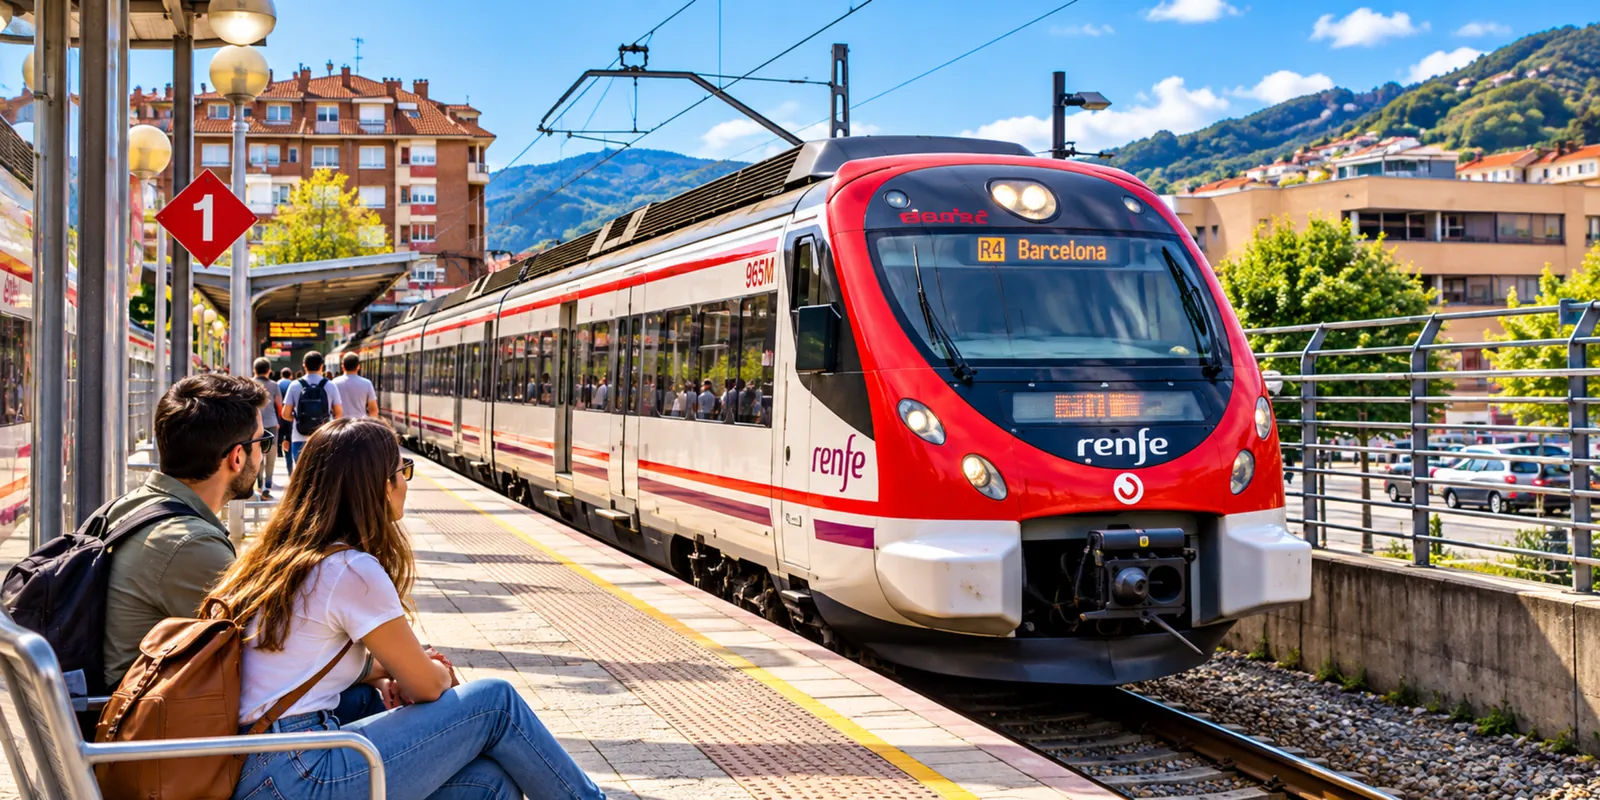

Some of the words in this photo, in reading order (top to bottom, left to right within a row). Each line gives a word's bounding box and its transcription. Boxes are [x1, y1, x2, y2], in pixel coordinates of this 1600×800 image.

[193, 194, 213, 242] 1
[980, 239, 1004, 259] R4
[1018, 239, 1107, 261] Barcelona
[746, 257, 775, 288] 965M
[812, 434, 866, 492] renfe
[1077, 428, 1168, 466] renfe
